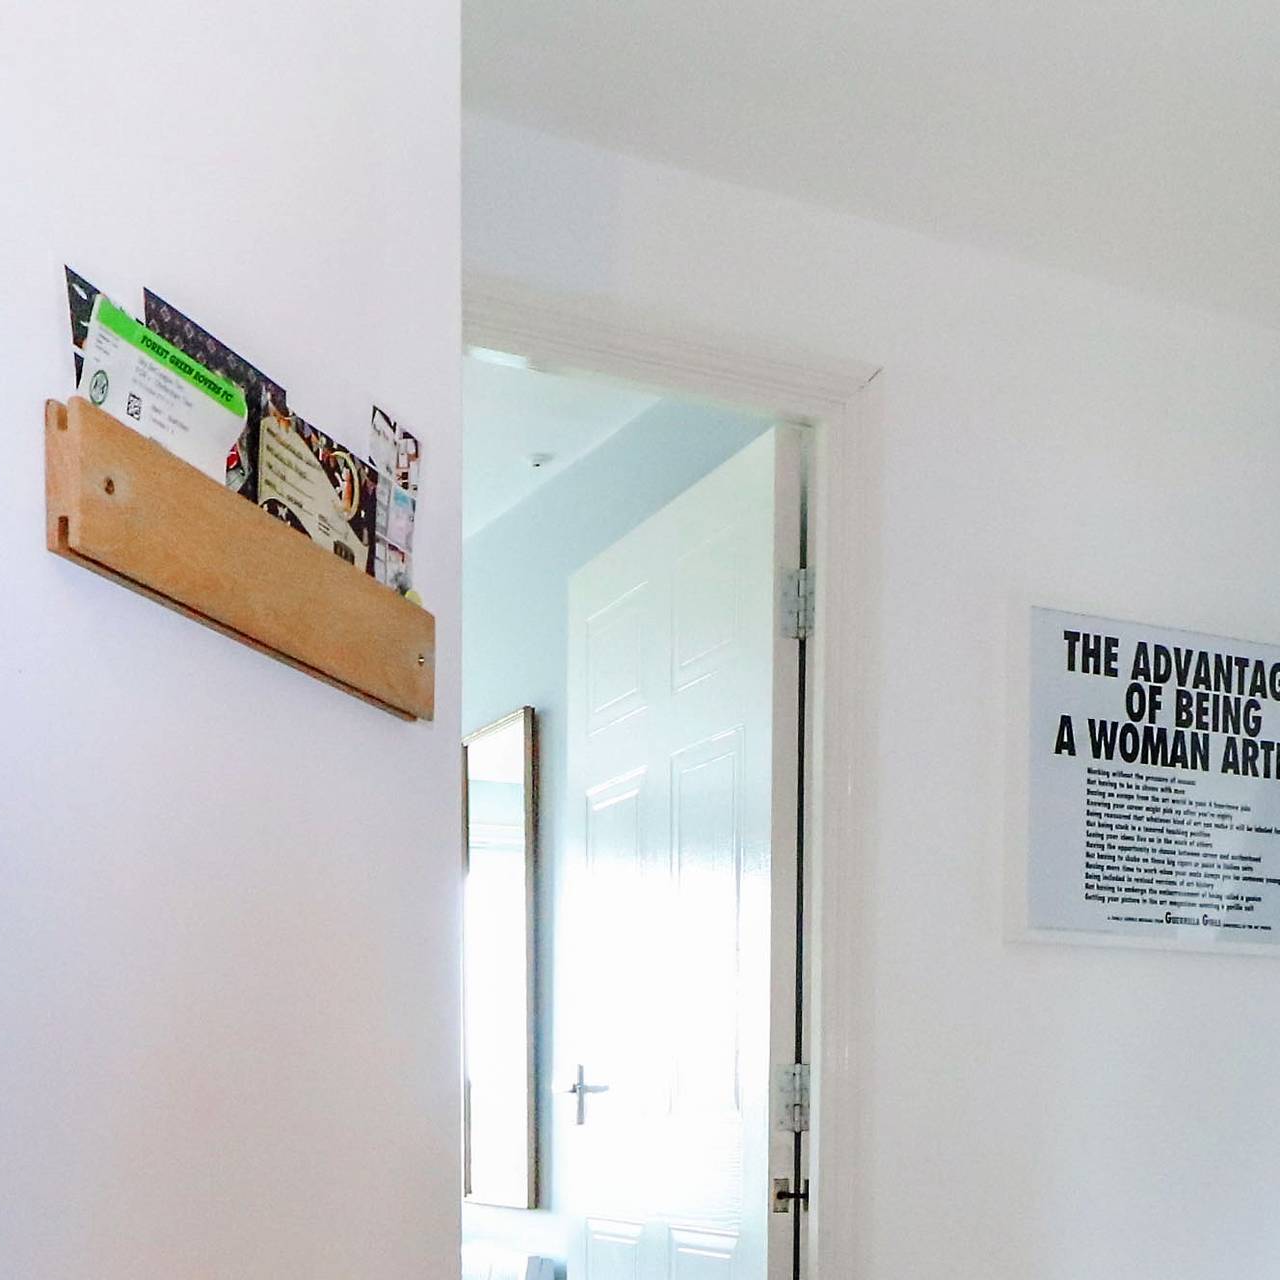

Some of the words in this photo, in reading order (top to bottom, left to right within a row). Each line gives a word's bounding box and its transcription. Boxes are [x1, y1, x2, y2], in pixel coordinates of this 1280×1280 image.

[141, 335, 170, 359] FOREST
[169, 353, 195, 377] GREEN
[1063, 630, 1119, 678] THE
[1125, 682, 1163, 724] OF
[1175, 688, 1262, 738] BEING
[1054, 714, 1076, 756] A
[1087, 718, 1210, 772] WOMAN
